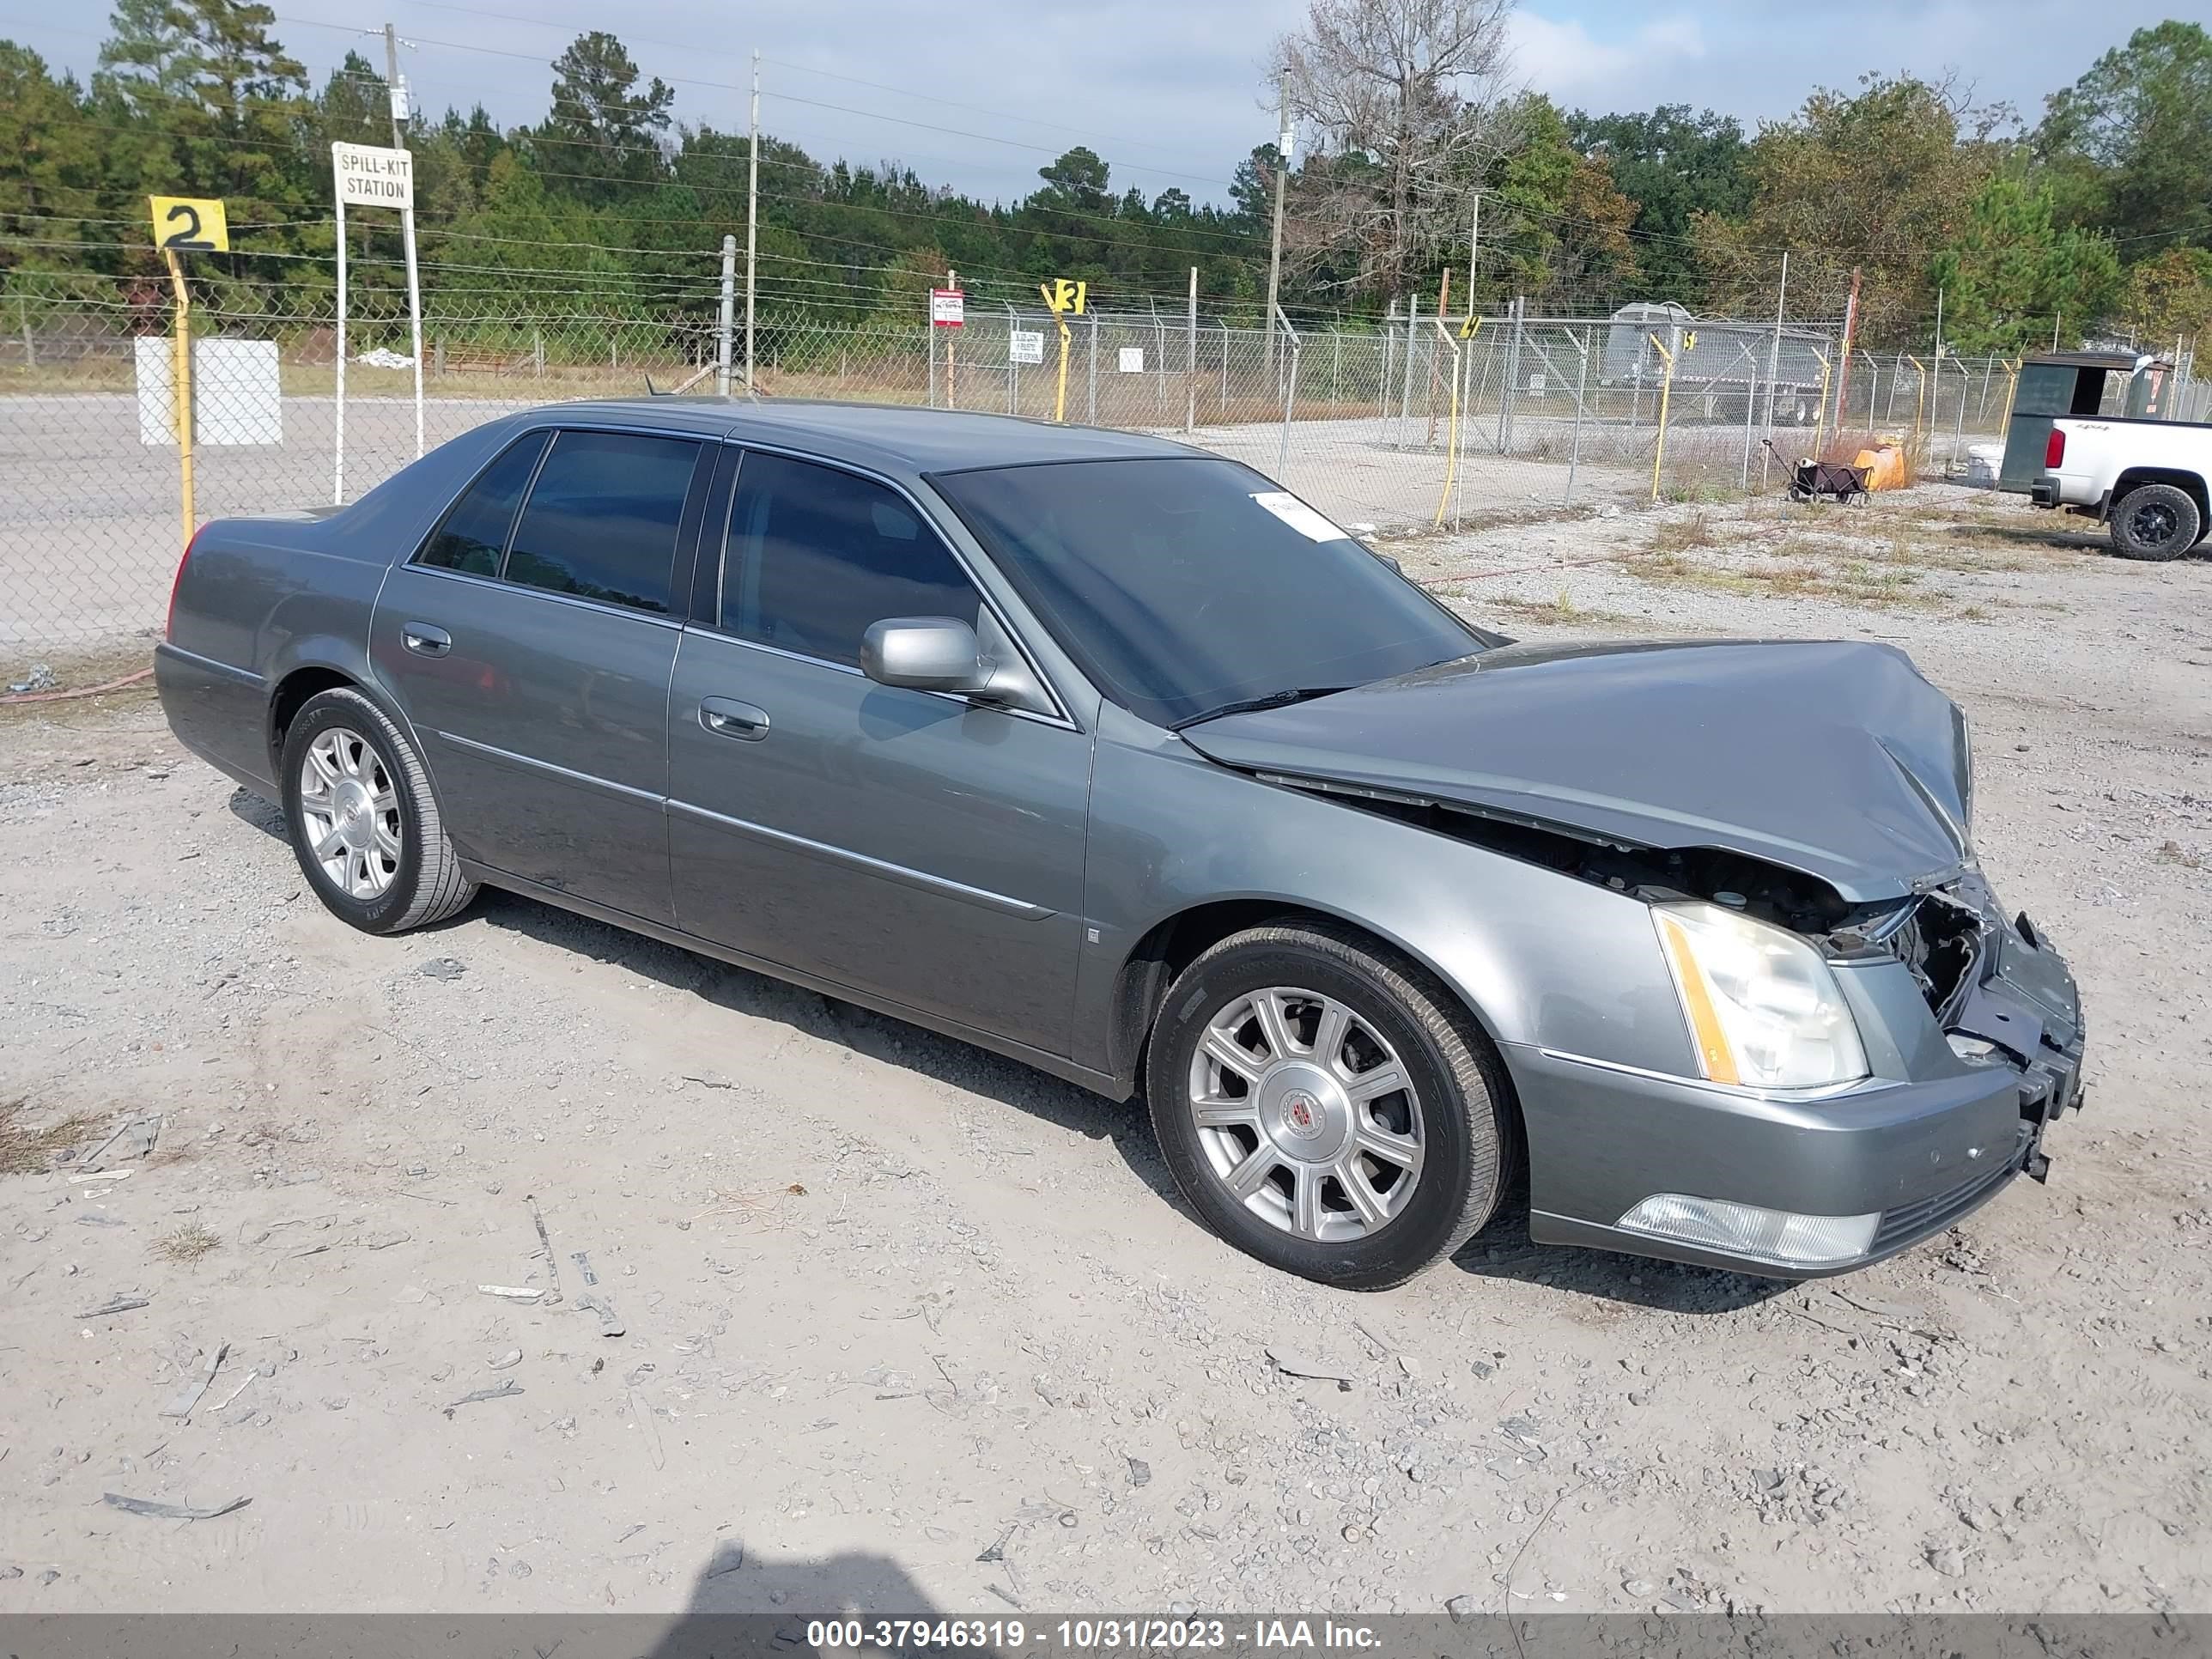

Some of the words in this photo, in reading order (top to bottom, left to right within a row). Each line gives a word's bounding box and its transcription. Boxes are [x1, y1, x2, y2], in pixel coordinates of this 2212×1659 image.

[342, 154, 409, 177] SPILL-KIT
[347, 177, 404, 198] STATION
[163, 205, 216, 249] 2
[1062, 282, 1079, 313] 3
[1467, 315, 1480, 339] 4
